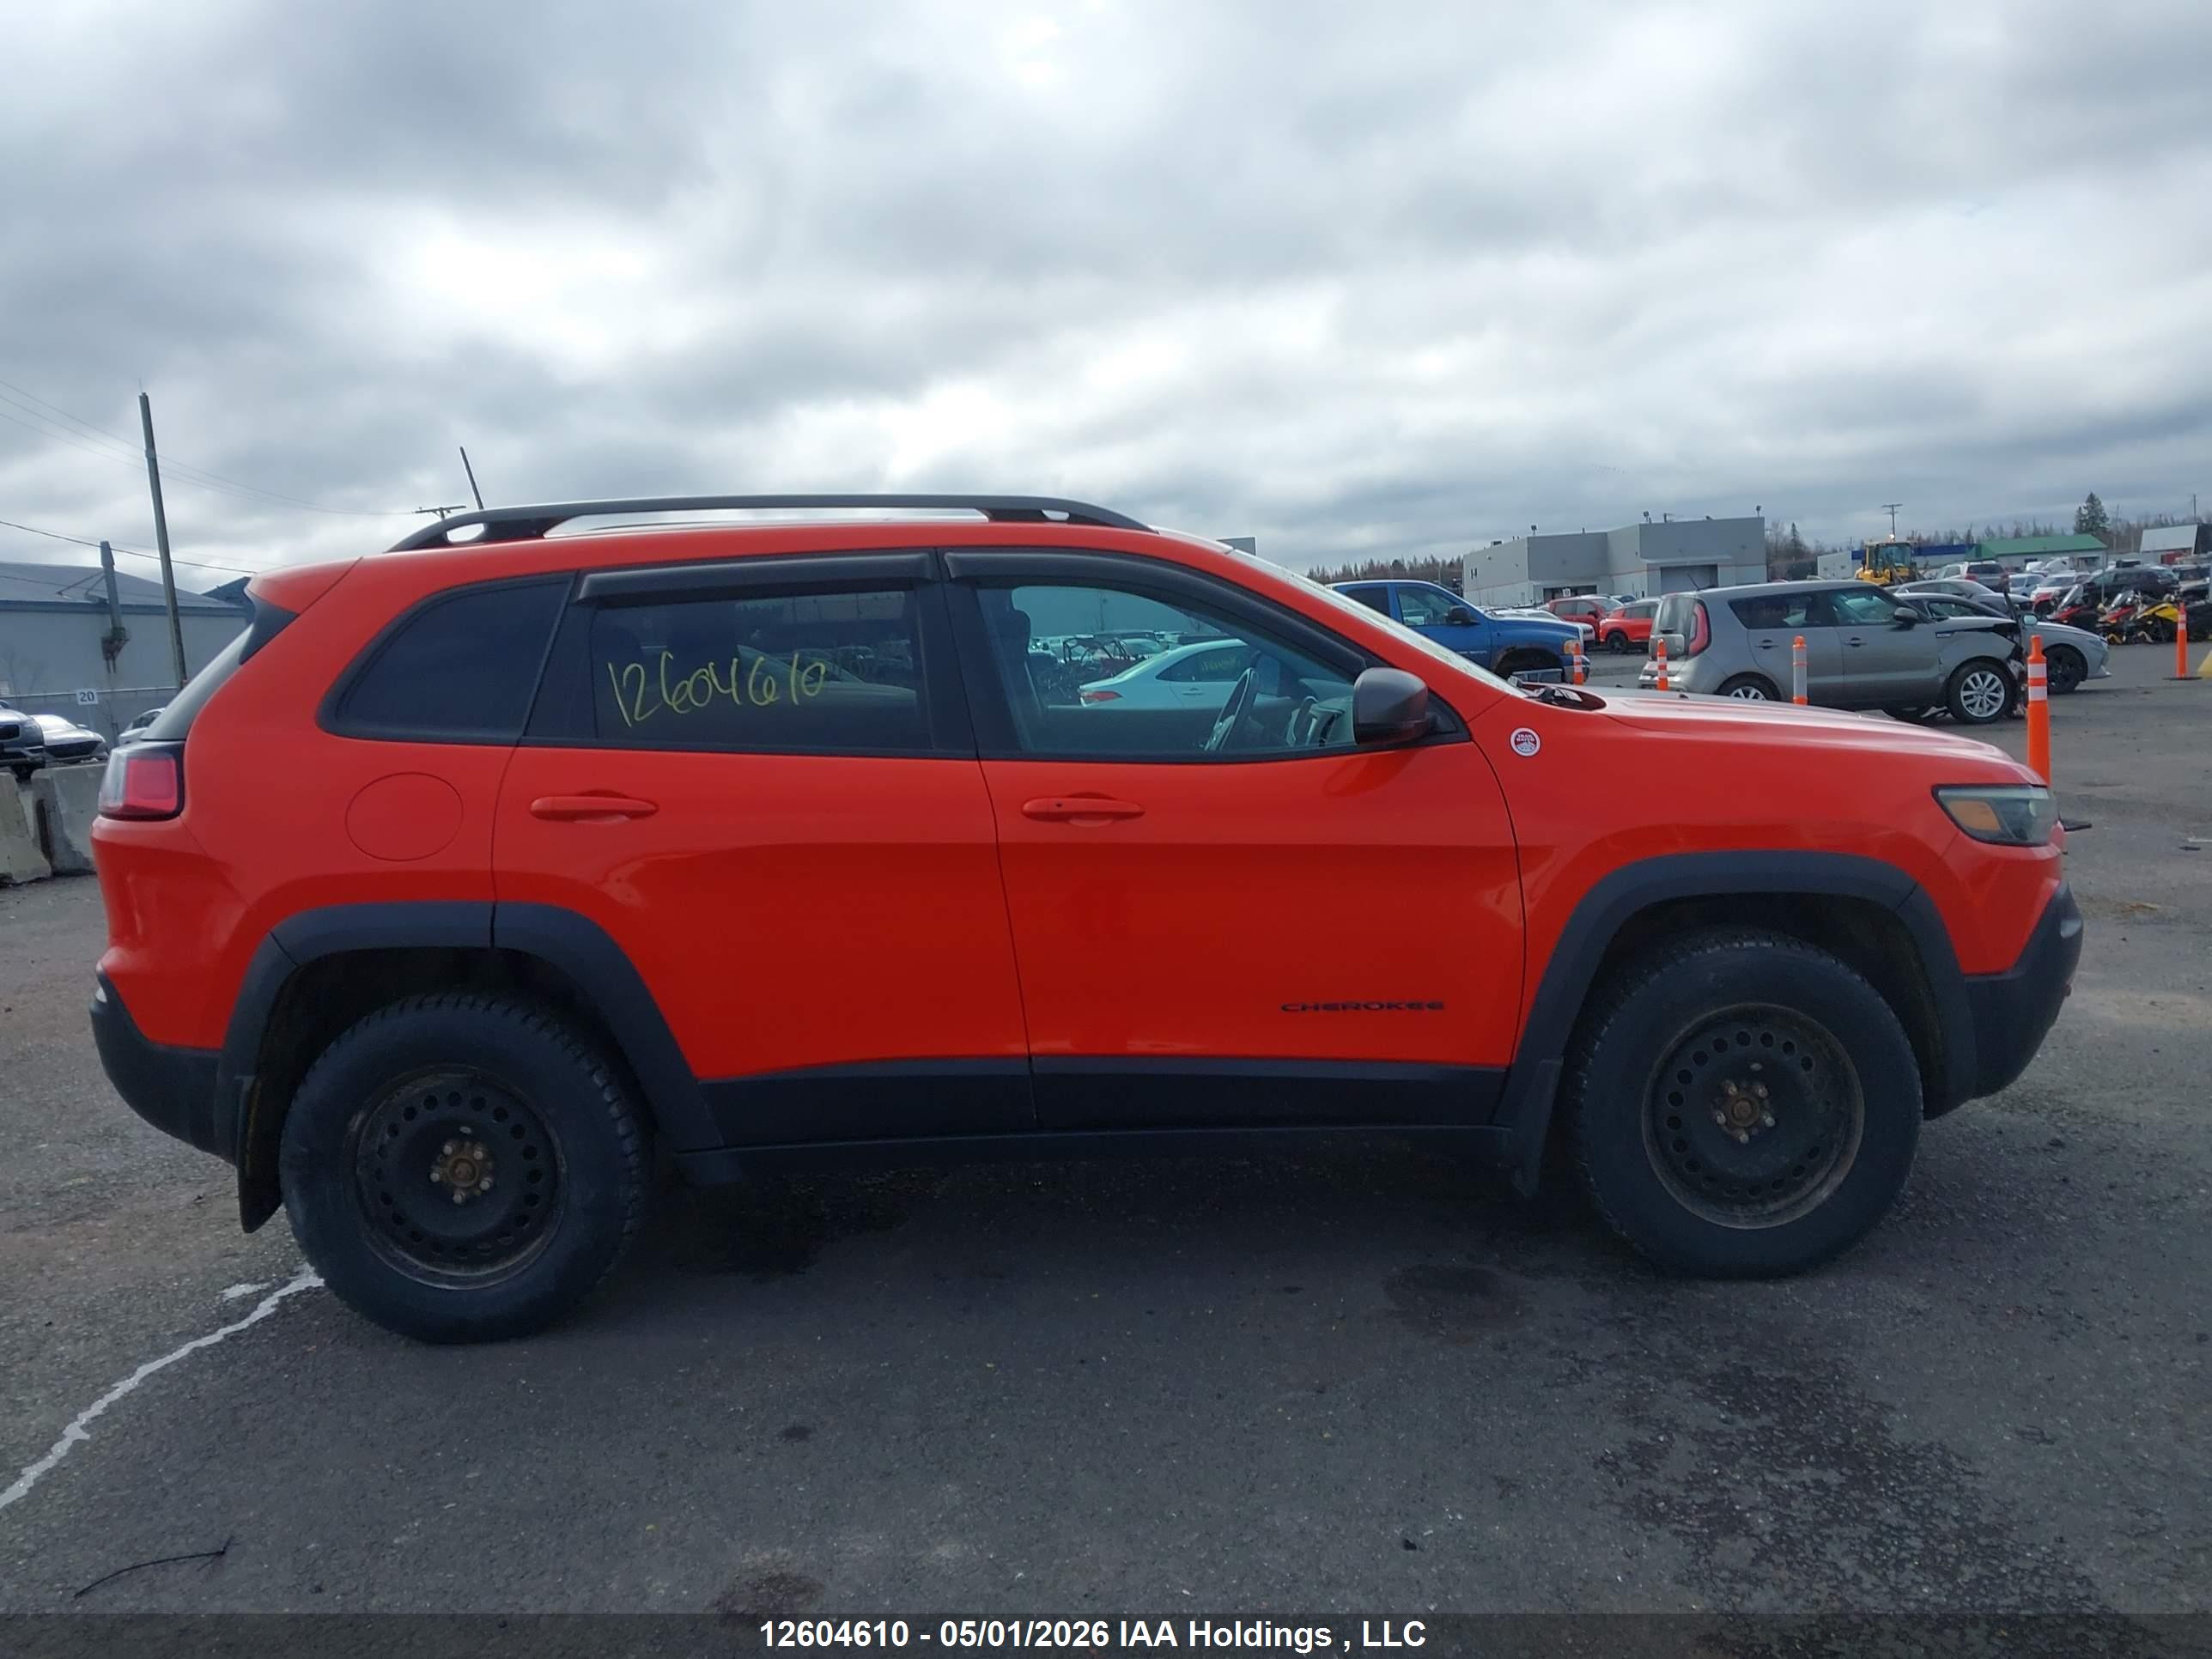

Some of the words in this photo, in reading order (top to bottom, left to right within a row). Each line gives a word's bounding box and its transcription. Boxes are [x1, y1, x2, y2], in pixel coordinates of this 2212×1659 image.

[607, 650, 827, 728] 12604610
[79, 690, 95, 702] 20
[1279, 1000, 1445, 1012] CHEROKEE
